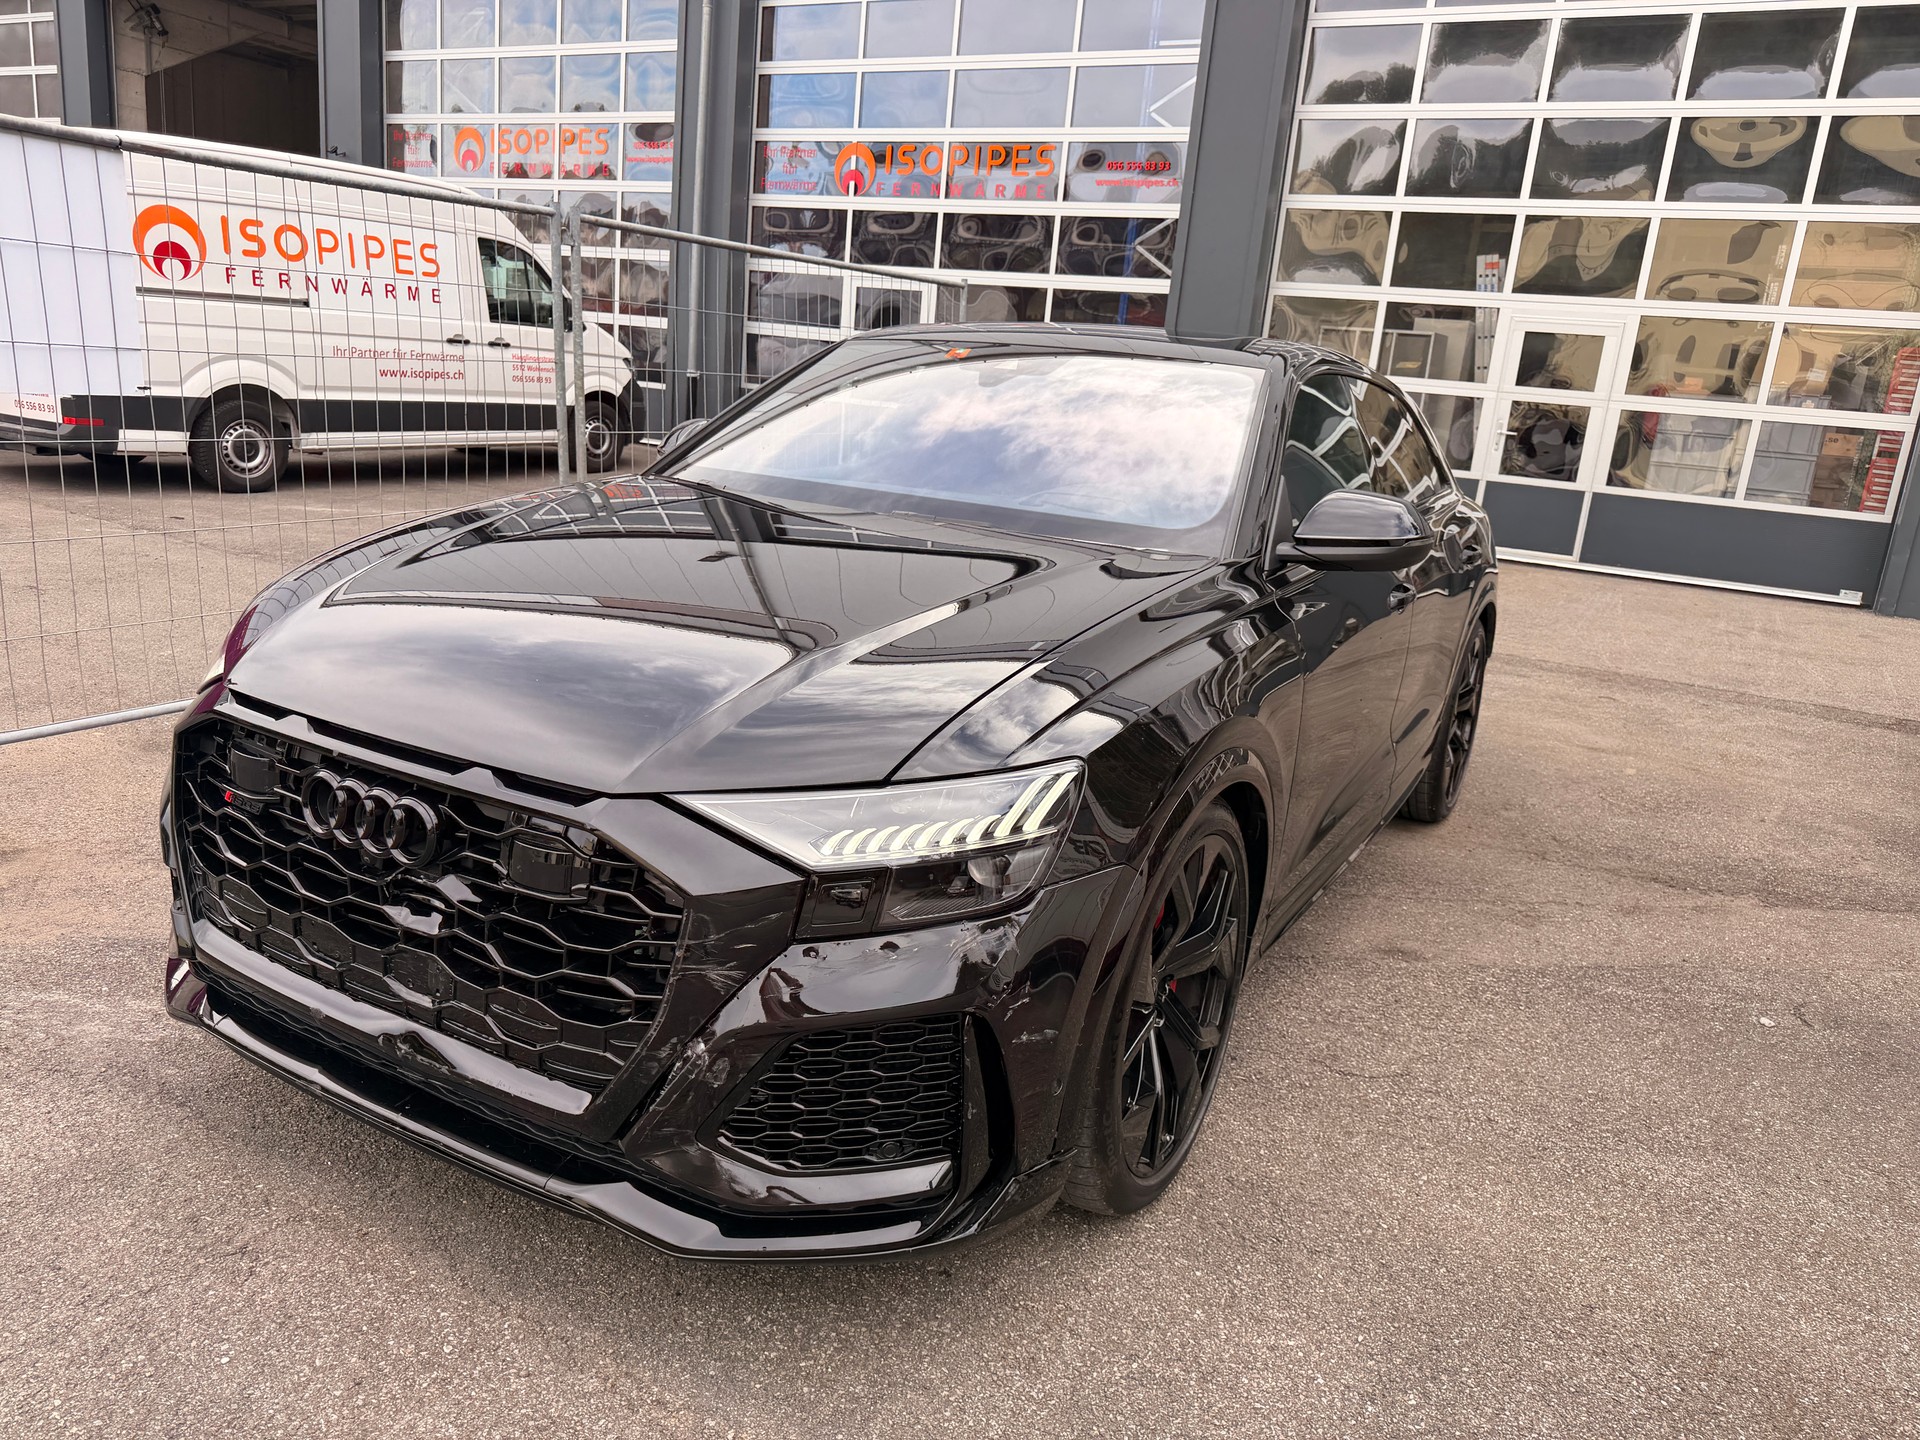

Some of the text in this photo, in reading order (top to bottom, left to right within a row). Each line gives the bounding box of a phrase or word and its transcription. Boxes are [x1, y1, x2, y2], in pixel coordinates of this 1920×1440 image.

[490, 127, 609, 155] ISOPIPES
[763, 145, 817, 159] Ihr Partner
[783, 161, 797, 174] für
[885, 144, 1056, 177] ISOPIPES
[1106, 161, 1171, 171] 056 556 83 93
[490, 162, 610, 177] FERNWÄRME
[761, 178, 817, 190] Fernwärme
[875, 181, 1047, 198] FERNWÄRME
[1095, 178, 1179, 189] www.isopipes.ch
[220, 215, 441, 278] ISOPIPES
[226, 267, 441, 303] FERNWÄRME
[332, 345, 464, 363] Ihr Partner für Fernwärme
[379, 367, 464, 381] www.isopipes.ch
[512, 375, 523, 383] 056
[14, 399, 55, 413] 056 556 83 93
